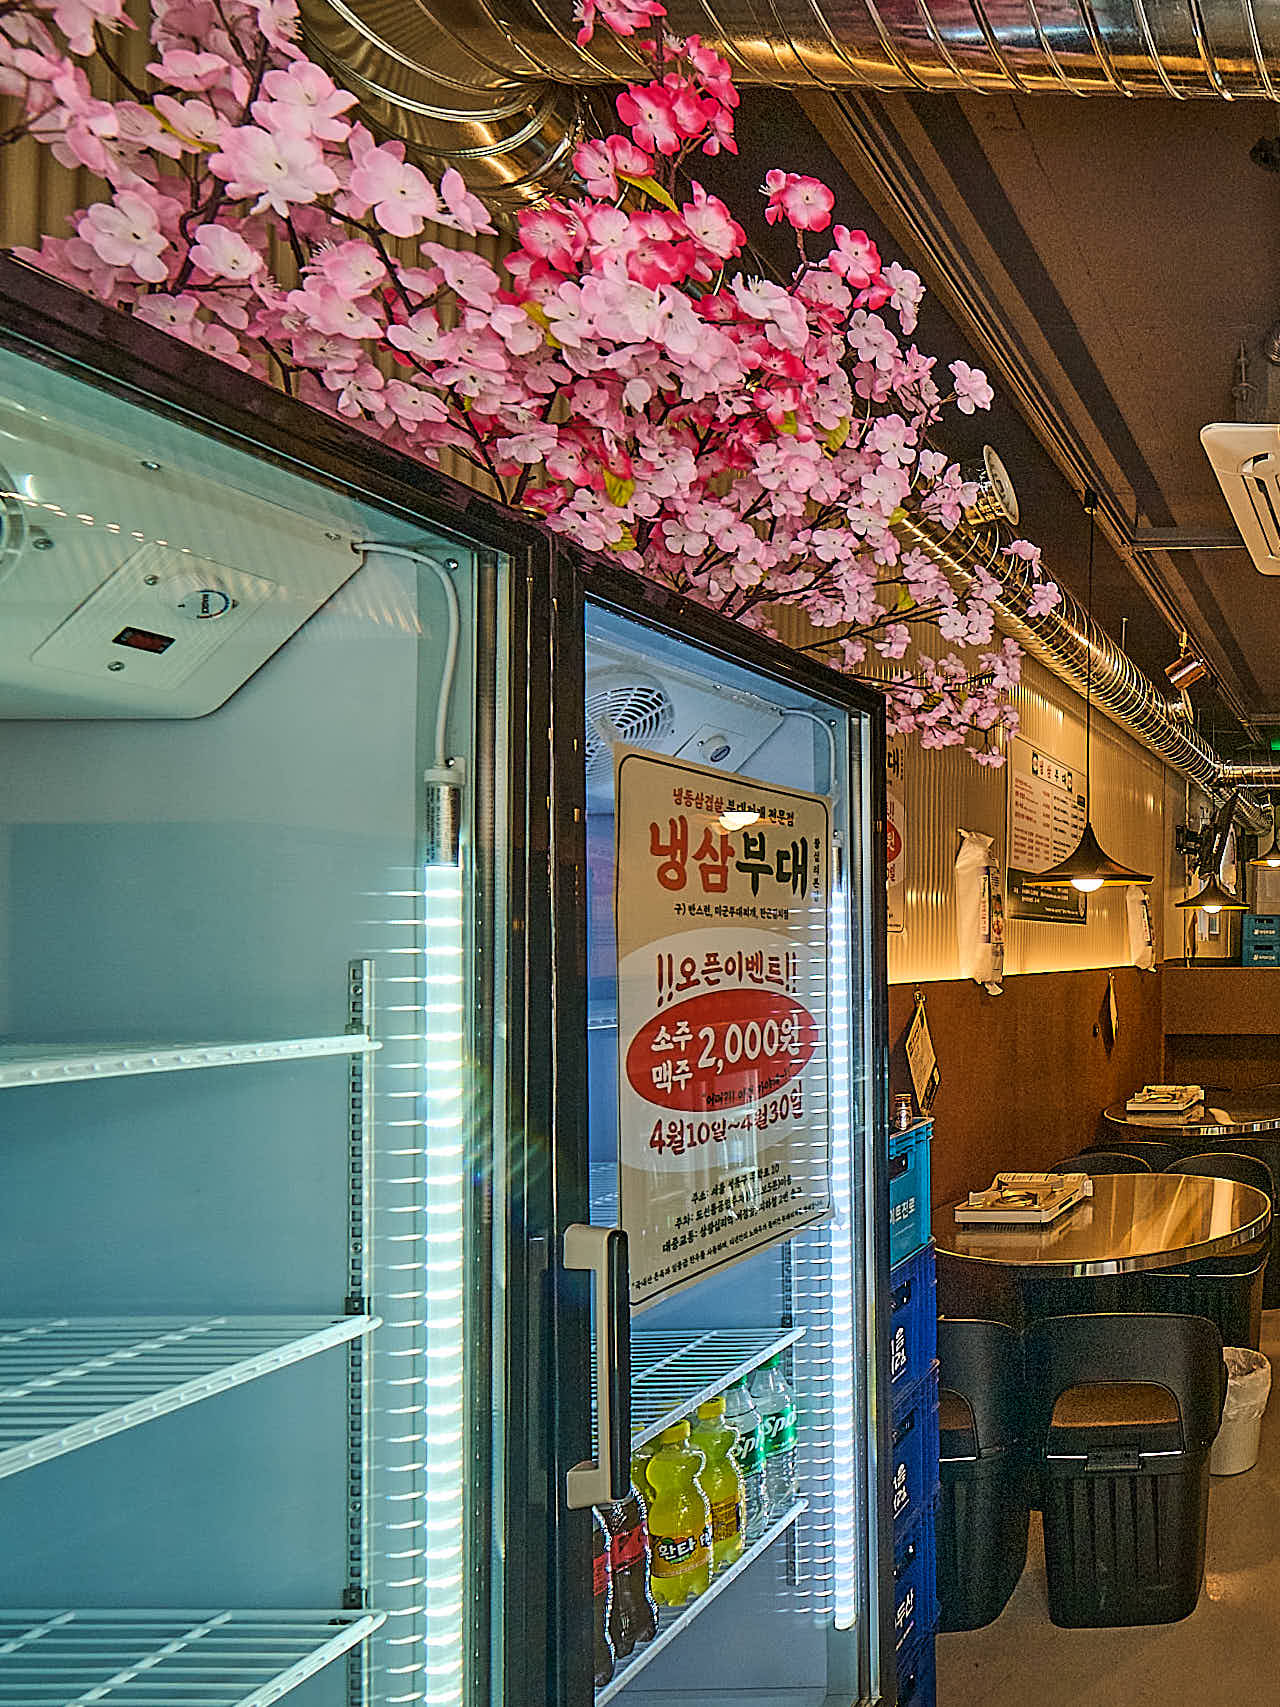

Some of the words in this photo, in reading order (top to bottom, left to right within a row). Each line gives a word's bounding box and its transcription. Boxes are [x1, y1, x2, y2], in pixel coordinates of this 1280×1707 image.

[673, 788, 724, 814] 냉동삼겹살
[768, 808, 794, 827] 전문점
[650, 815, 808, 900] 냉삼부대
[657, 950, 797, 1008] !!오픈이벤트!!
[651, 1021, 693, 1052] 소주
[698, 1012, 800, 1075] 2,000원
[651, 1059, 693, 1094] 맥주
[658, 1535, 697, 1560] 환타
